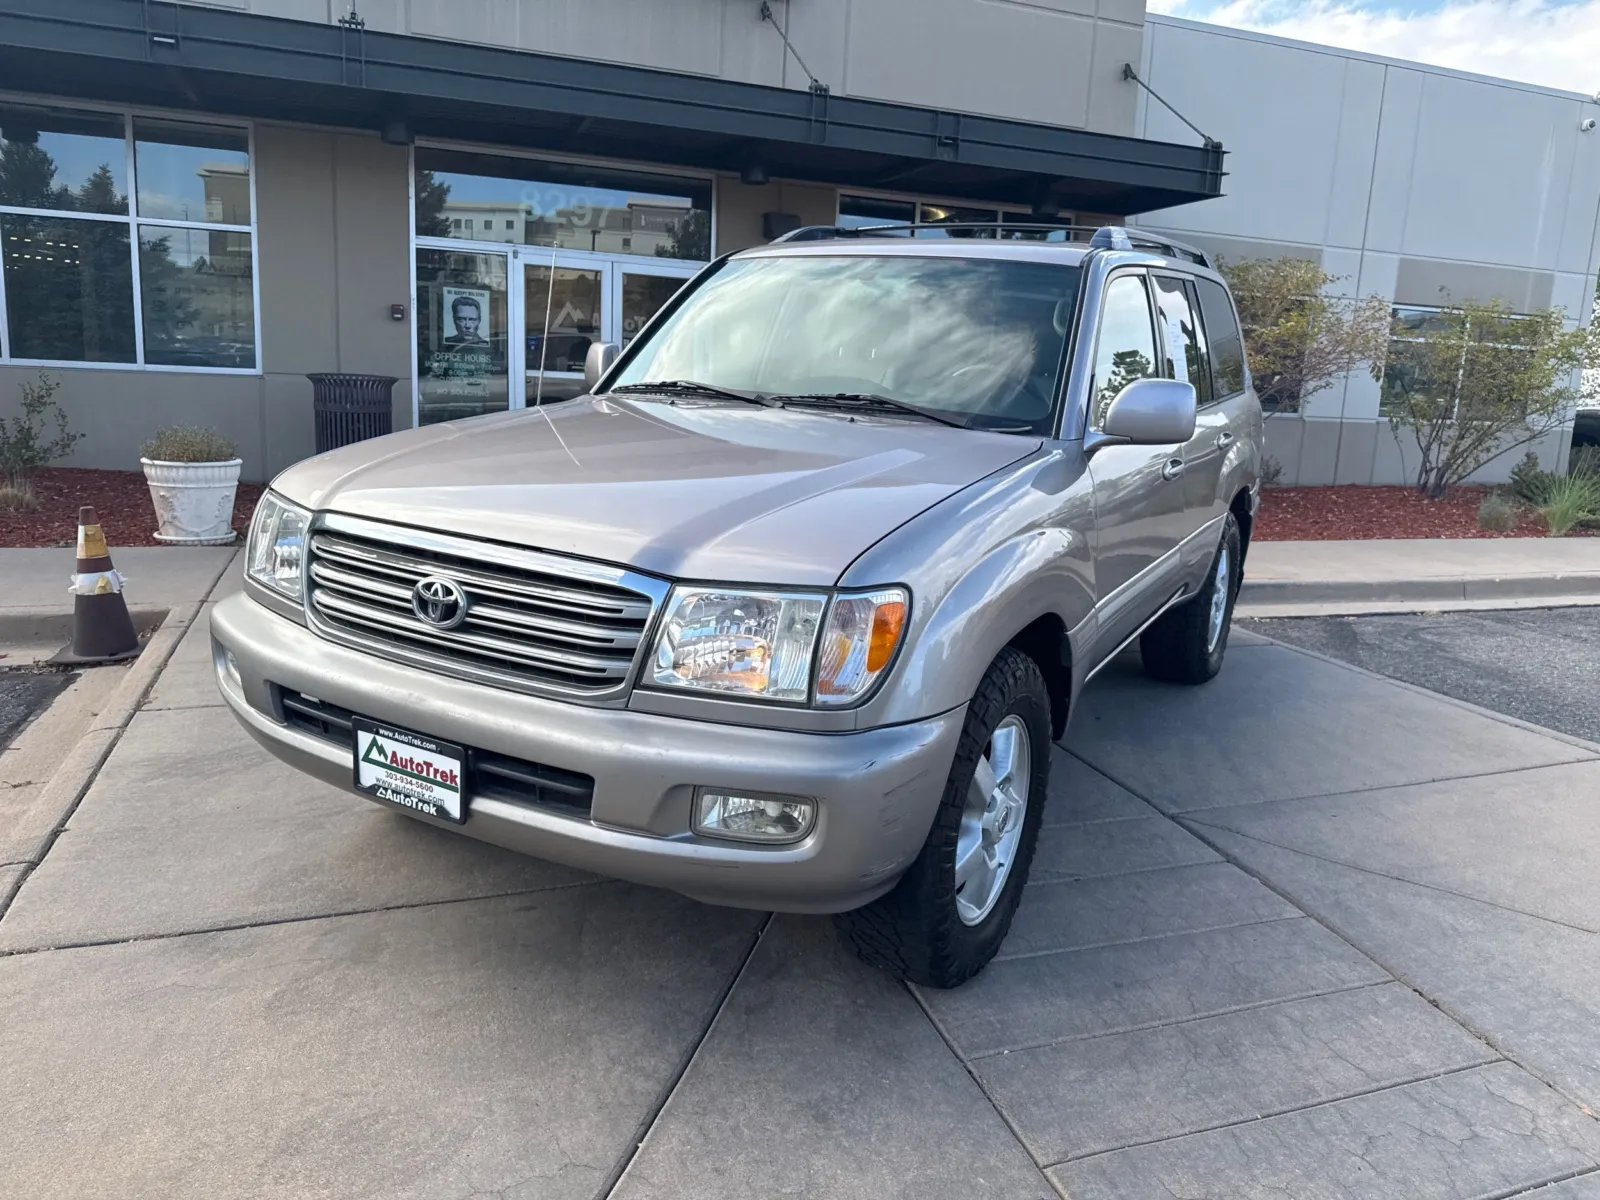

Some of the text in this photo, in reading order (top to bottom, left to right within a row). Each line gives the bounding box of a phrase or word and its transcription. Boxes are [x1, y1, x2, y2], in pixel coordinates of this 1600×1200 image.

[518, 186, 616, 228] 8297
[435, 352, 492, 363] OFFICE HOURS
[379, 728, 436, 751] www.AutoTrek.com
[385, 771, 434, 793] 303-934-5600
[389, 751, 458, 786] AutoTrek
[375, 776, 445, 806] www.autotrek.com
[385, 788, 438, 816] AutoTrek
